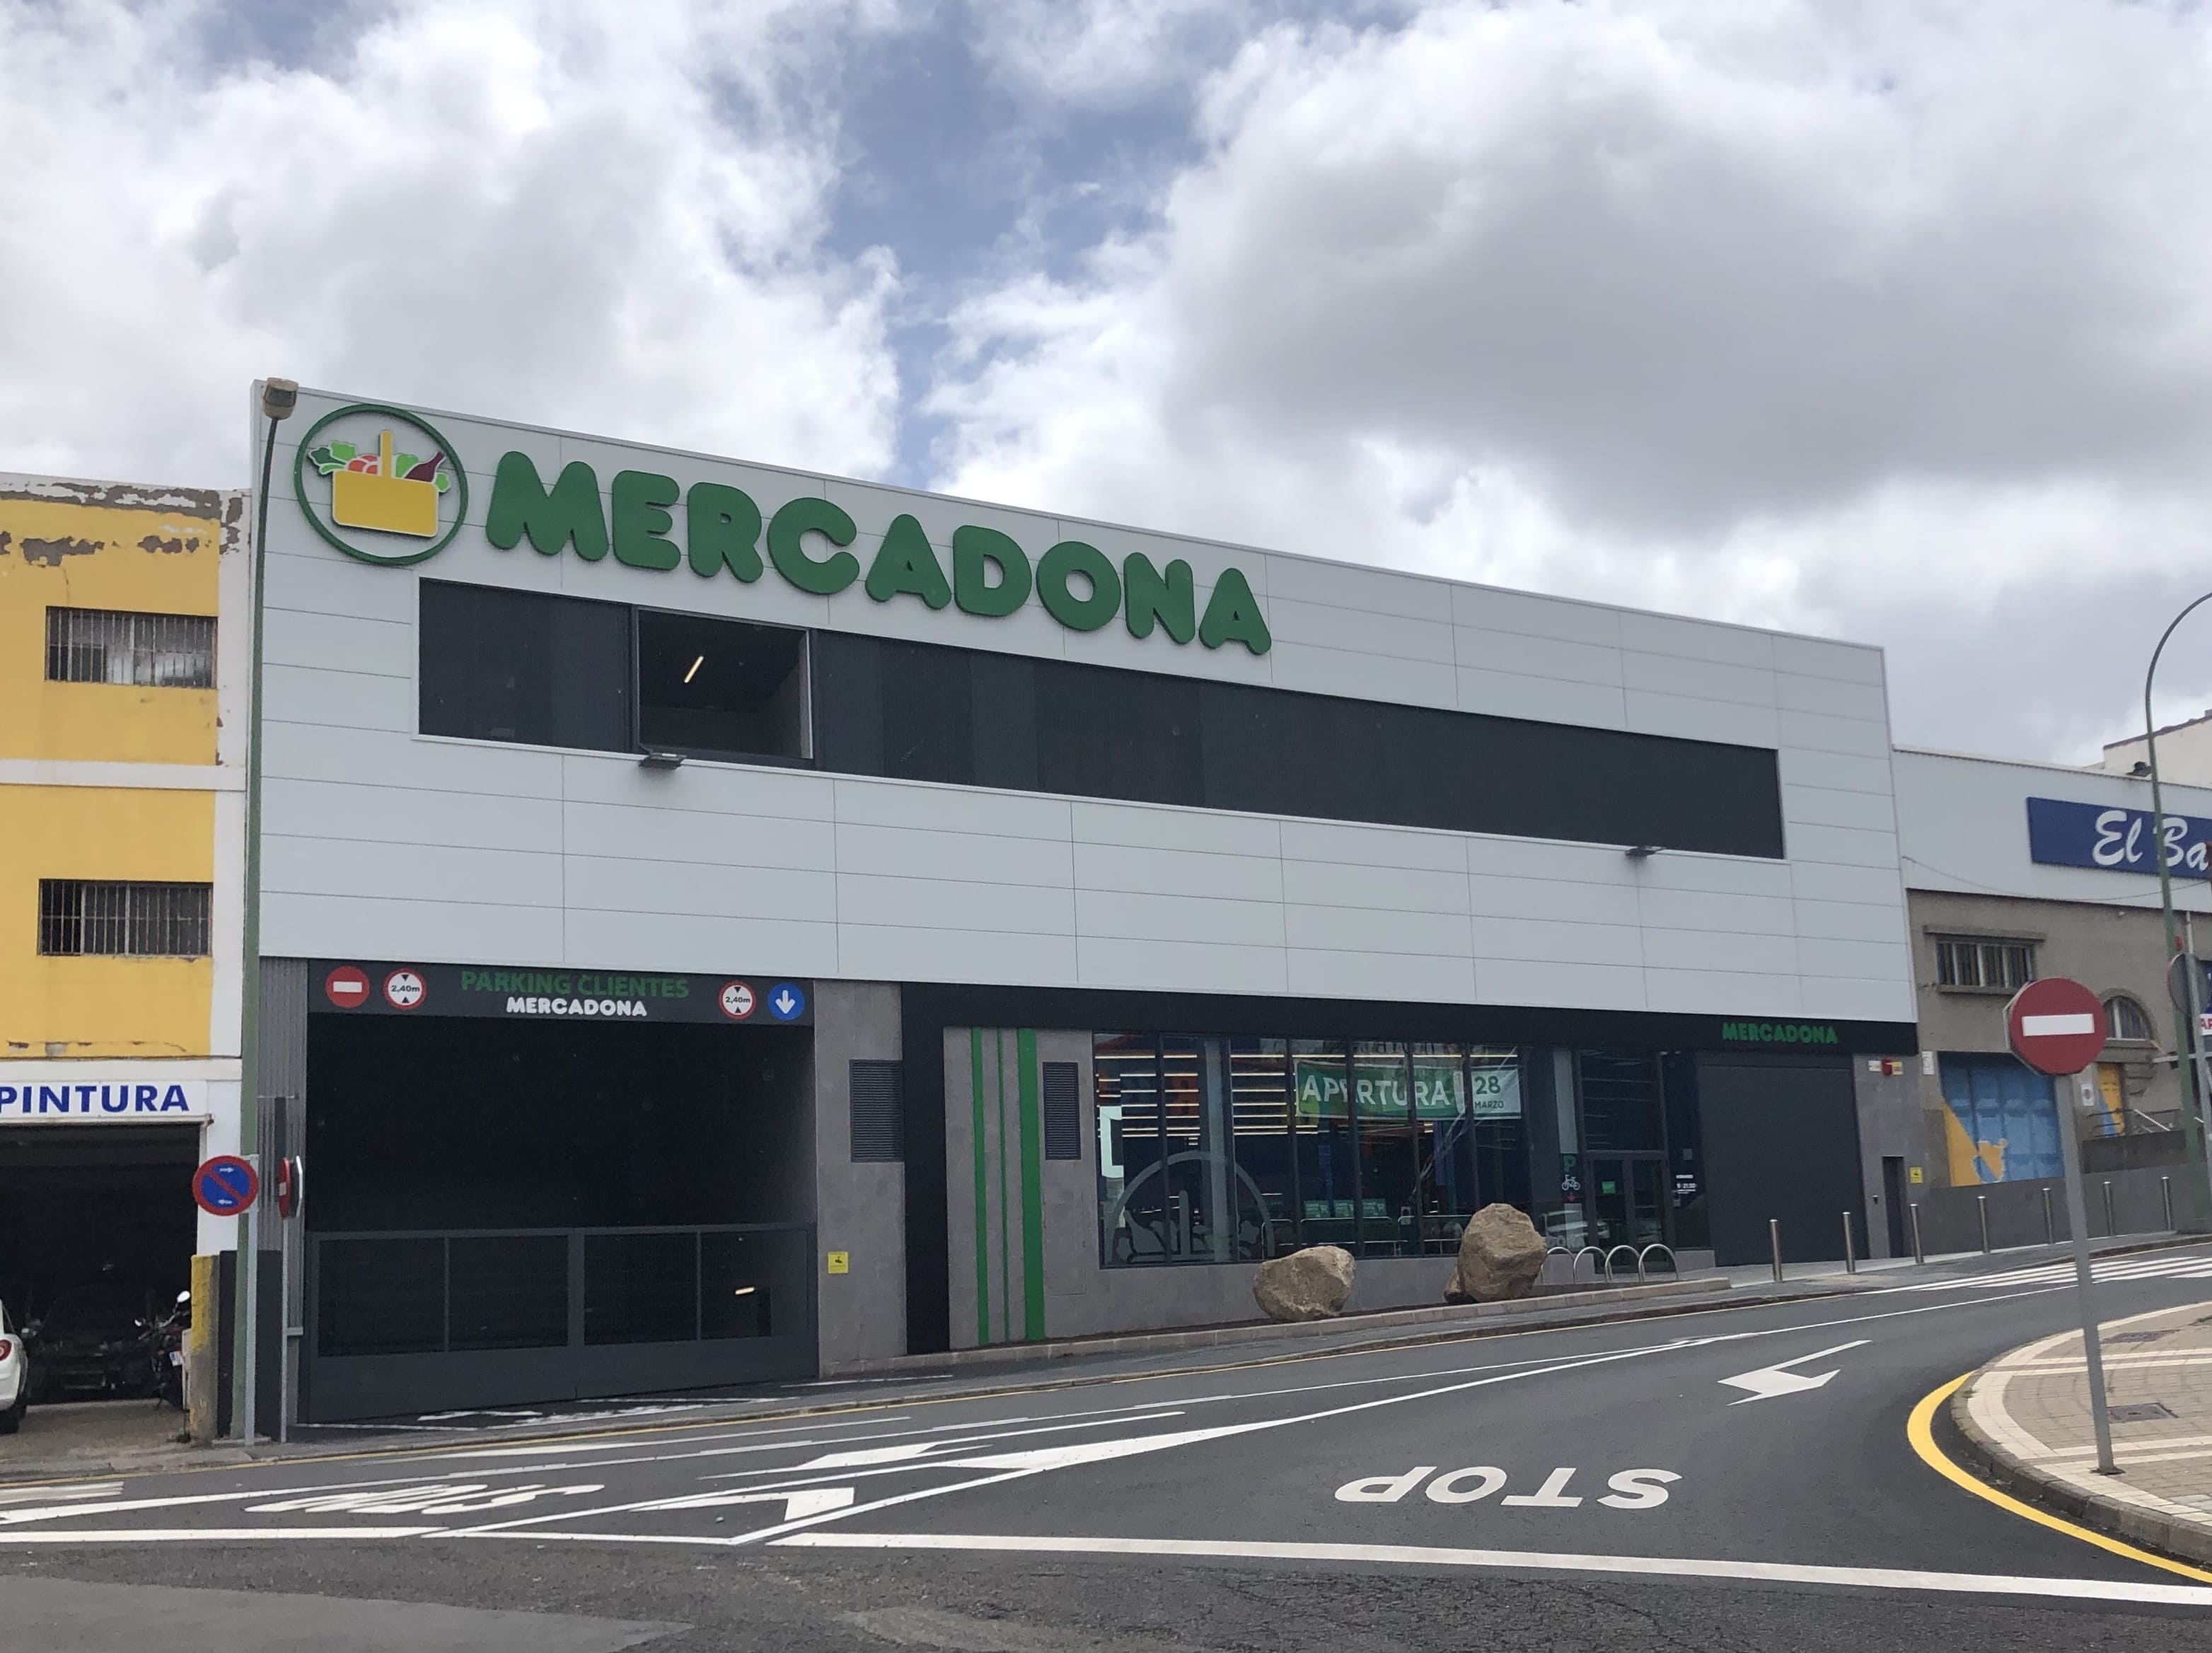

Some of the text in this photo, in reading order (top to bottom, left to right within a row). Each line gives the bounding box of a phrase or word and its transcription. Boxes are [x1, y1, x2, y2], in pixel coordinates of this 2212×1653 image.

[486, 451, 1272, 656] MERCADONA
[2092, 810, 2143, 866] El
[461, 971, 689, 999] PARKING CLIENTES
[506, 997, 647, 1017] MERCADONA
[726, 996, 751, 1004] 2,40m
[1722, 1022, 1838, 1044] MERCADONA
[0, 1085, 190, 1114] PINTURA
[1302, 1074, 1451, 1106] APRTURA
[1474, 1076, 1501, 1095] 28
[1474, 1100, 1505, 1110] MARZO
[1334, 1466, 1682, 1509] STOP
